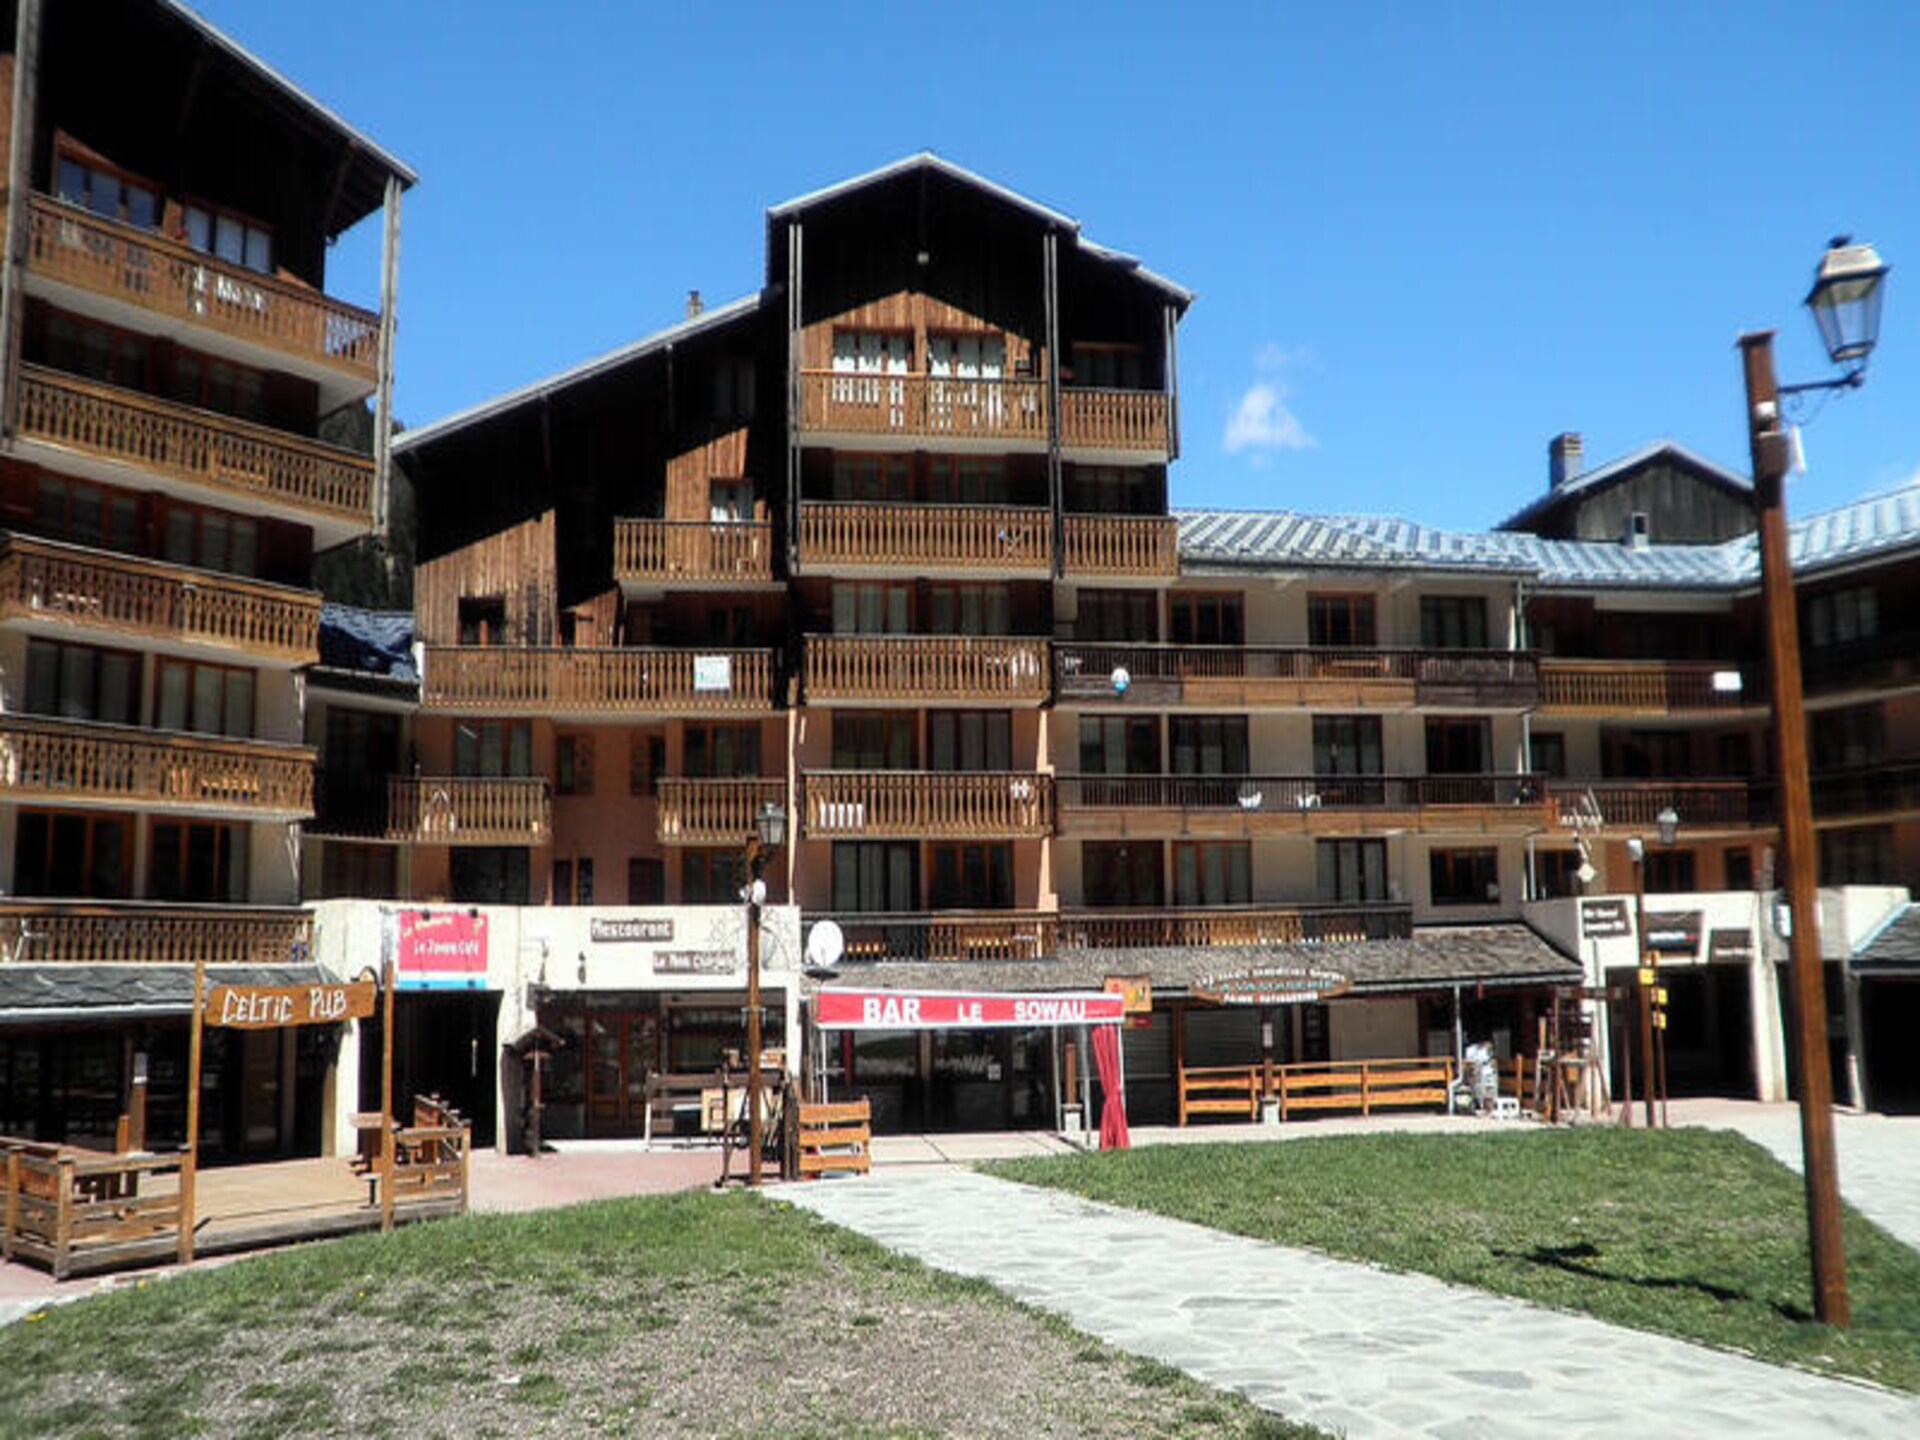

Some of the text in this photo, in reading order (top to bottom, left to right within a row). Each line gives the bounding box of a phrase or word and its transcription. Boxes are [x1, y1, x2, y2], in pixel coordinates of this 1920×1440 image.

[309, 986, 347, 1018] PUB
[862, 998, 920, 1024] BAR
[957, 1002, 983, 1022] LE
